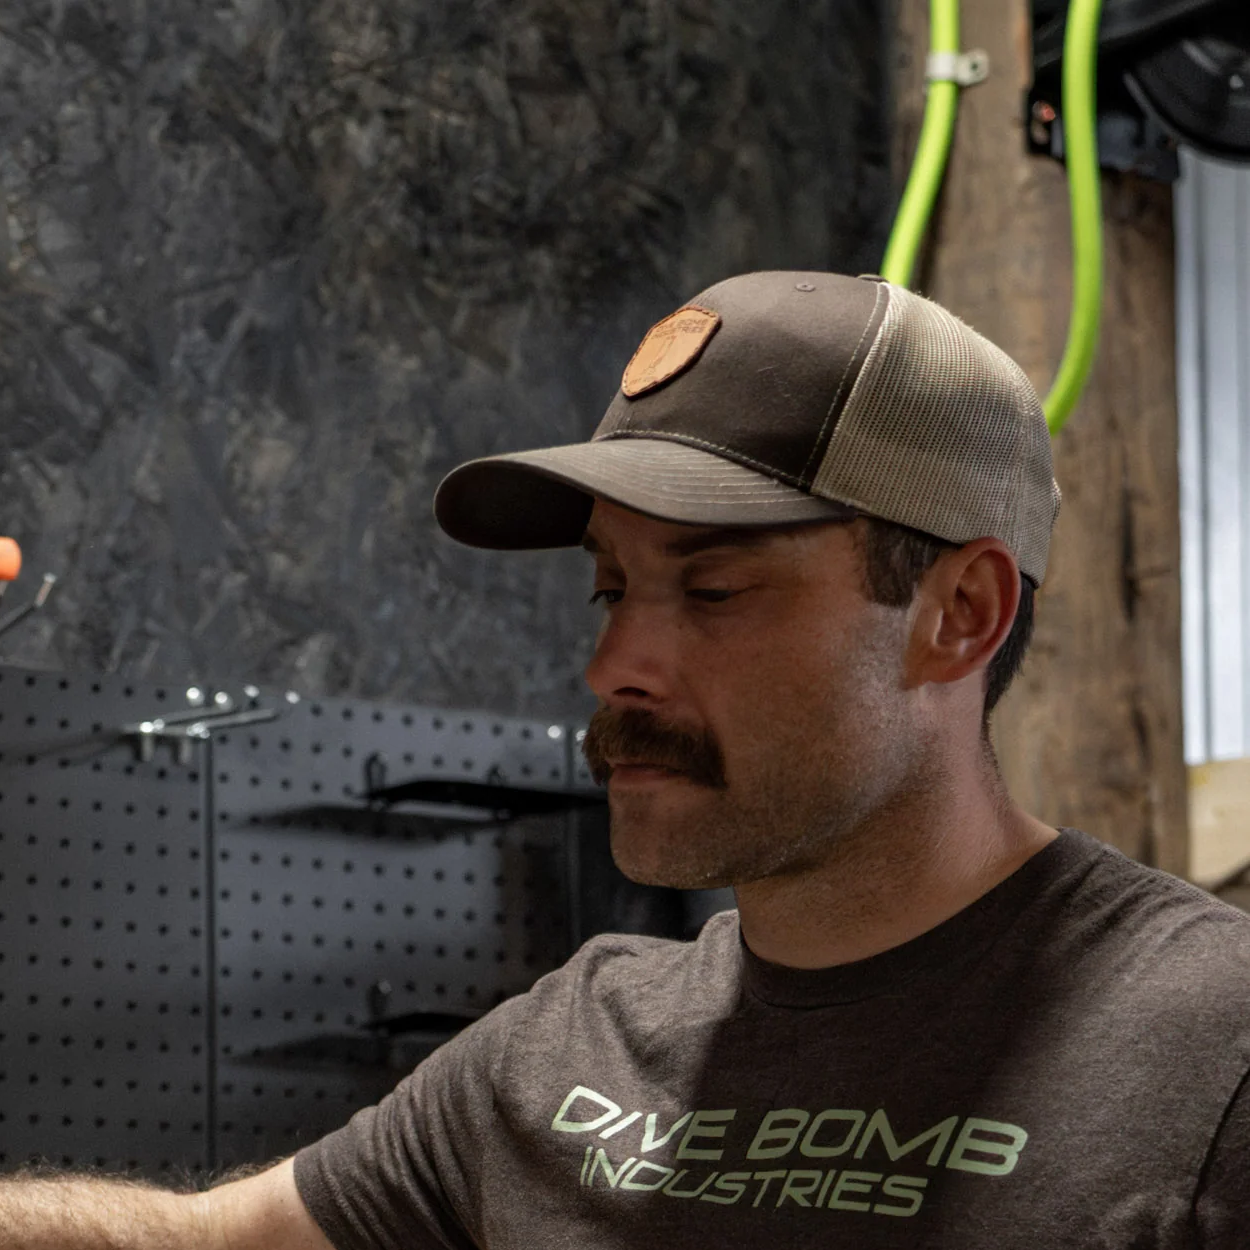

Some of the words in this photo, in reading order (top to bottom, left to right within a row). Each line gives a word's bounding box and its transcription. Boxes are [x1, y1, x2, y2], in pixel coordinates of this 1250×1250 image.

[551, 1085, 737, 1160] DIVE
[746, 1108, 1029, 1177] BOMB
[580, 1146, 928, 1217] INDUSTRIES
